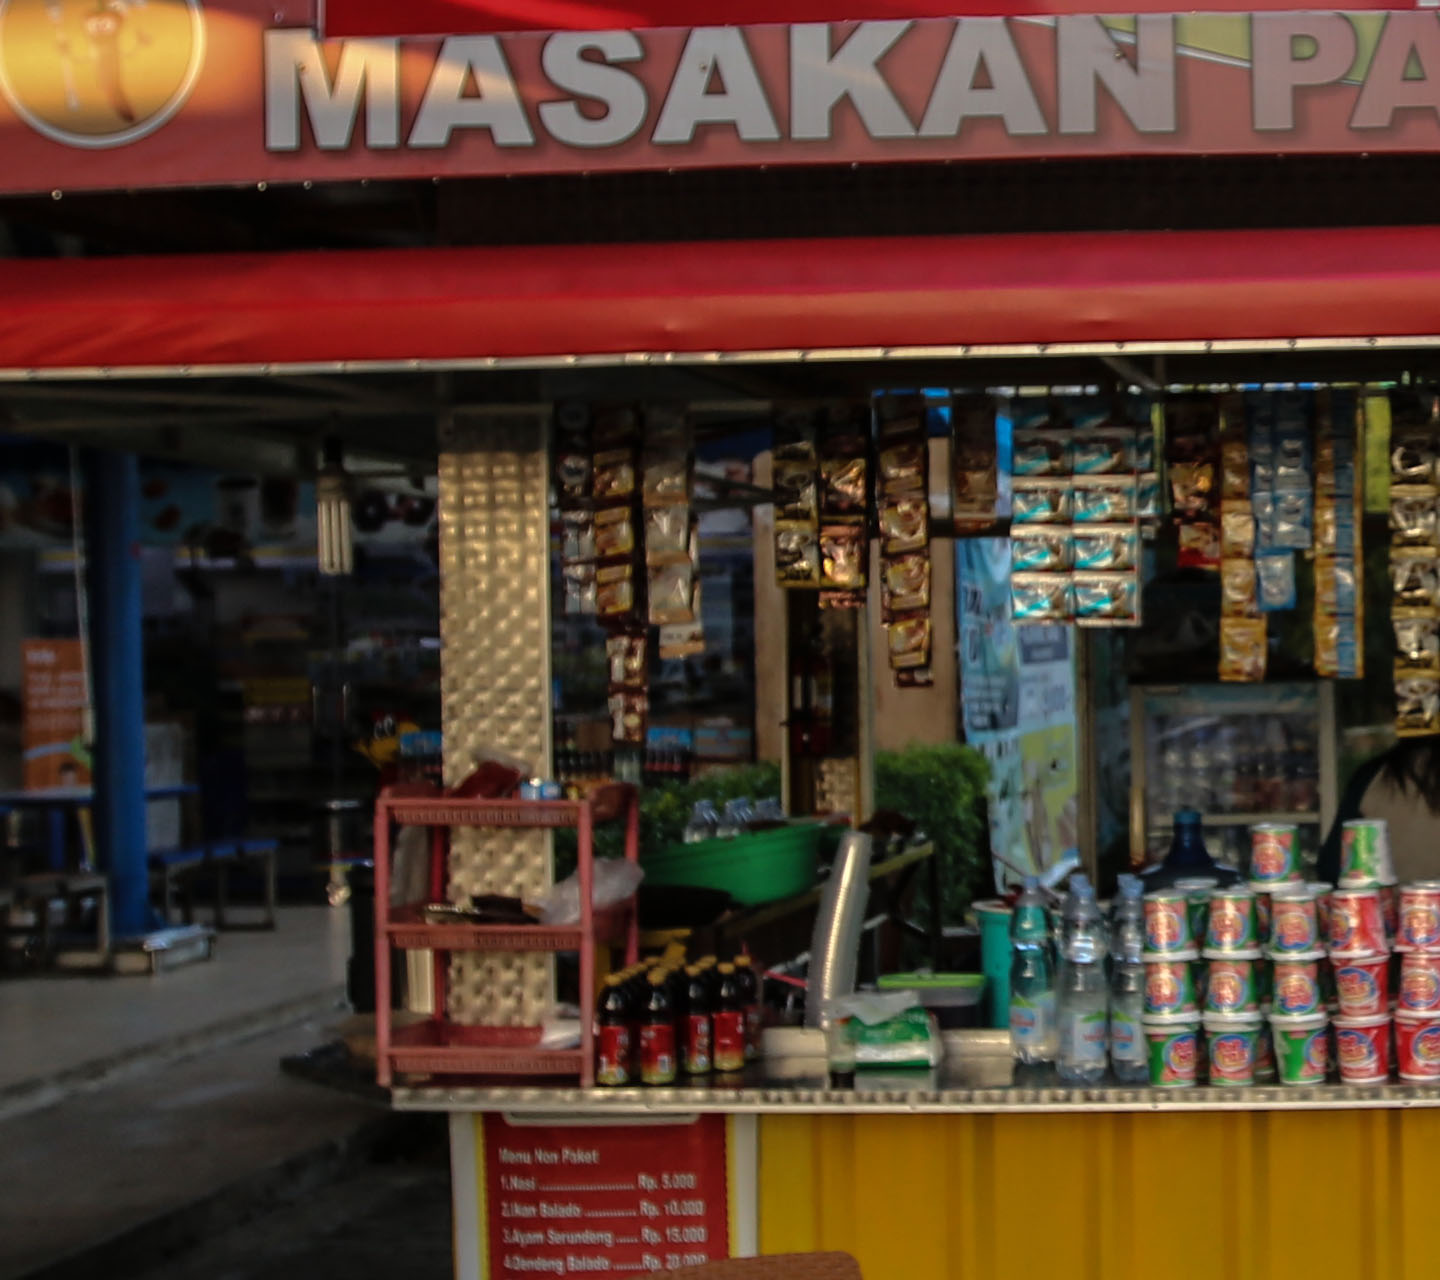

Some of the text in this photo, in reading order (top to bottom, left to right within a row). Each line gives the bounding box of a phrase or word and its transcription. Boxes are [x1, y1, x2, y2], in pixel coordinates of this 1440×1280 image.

[263, 13, 1177, 151] MASAKAN
[499, 1148, 600, 1165] Menu Non Paket
